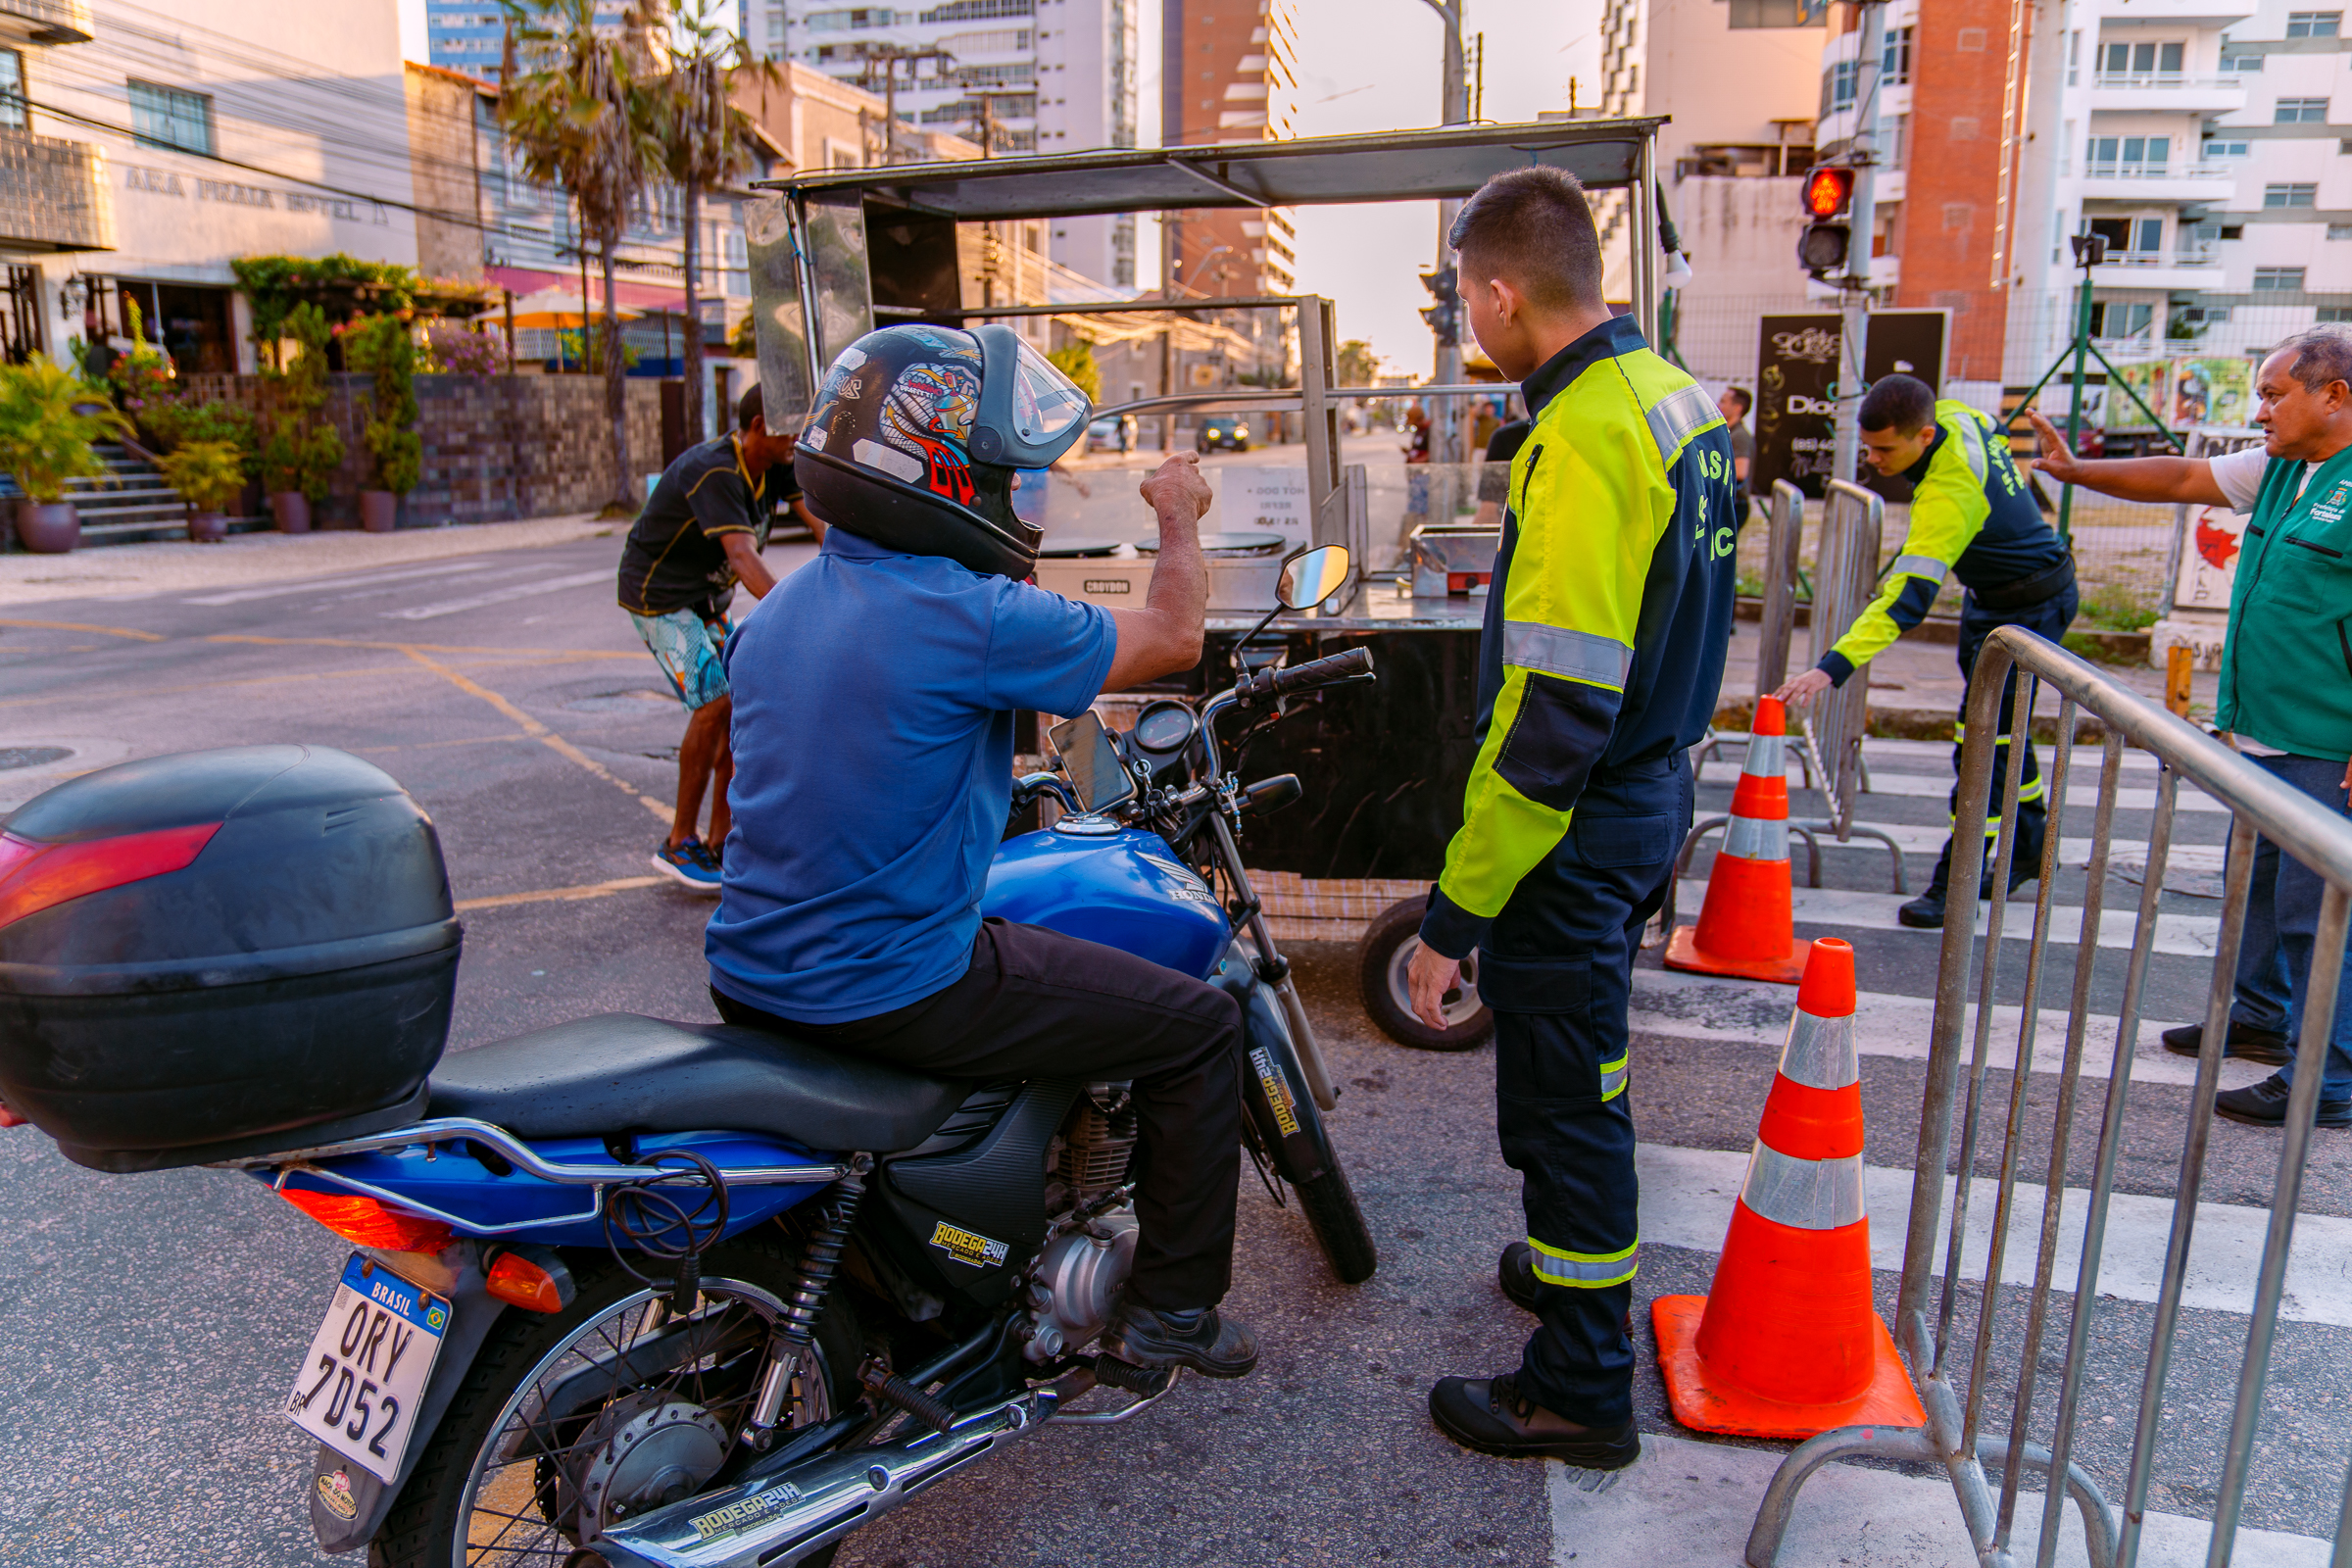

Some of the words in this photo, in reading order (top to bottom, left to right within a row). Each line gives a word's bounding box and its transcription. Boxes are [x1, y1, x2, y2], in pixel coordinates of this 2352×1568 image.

[198, 177, 275, 210] PRAIA
[287, 192, 361, 221] HOTEL
[1787, 395, 1840, 418] Diag
[2309, 508, 2342, 520] Fortaleza
[1086, 581, 1129, 592] CROYDON
[932, 1223, 1007, 1261] BODEGA24H
[941, 1241, 975, 1255] MERCADO
[371, 1282, 412, 1316] BRASIL
[340, 1300, 416, 1385] ORY
[289, 1391, 306, 1417] BR
[303, 1353, 401, 1460] 7D52
[692, 1483, 802, 1540] BODEGA24H
[714, 1514, 761, 1534] MERCADO
[774, 1495, 804, 1510] ADEGA
